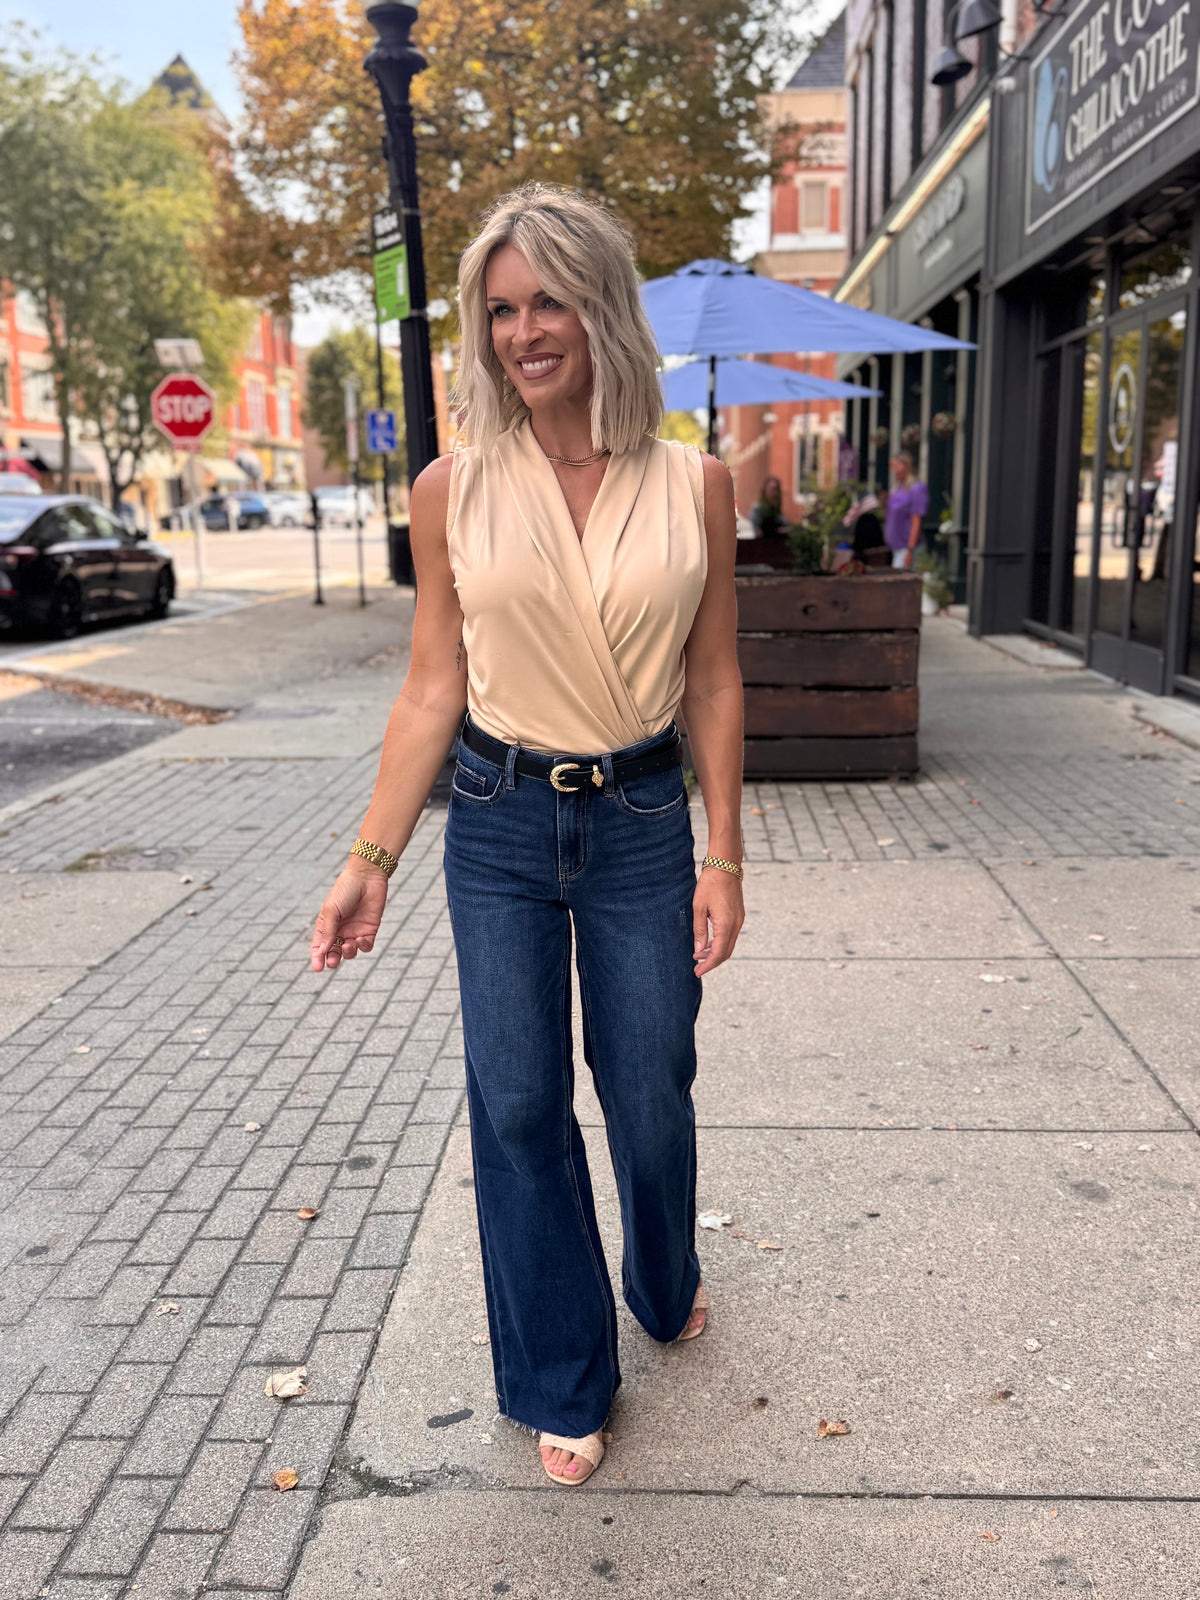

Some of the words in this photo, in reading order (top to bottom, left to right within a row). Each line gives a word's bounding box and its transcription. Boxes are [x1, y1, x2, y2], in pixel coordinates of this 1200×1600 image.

[1064, 1, 1190, 163] CHILLICOTHE
[1068, 1, 1110, 96] THE
[158, 394, 211, 423] STOP
